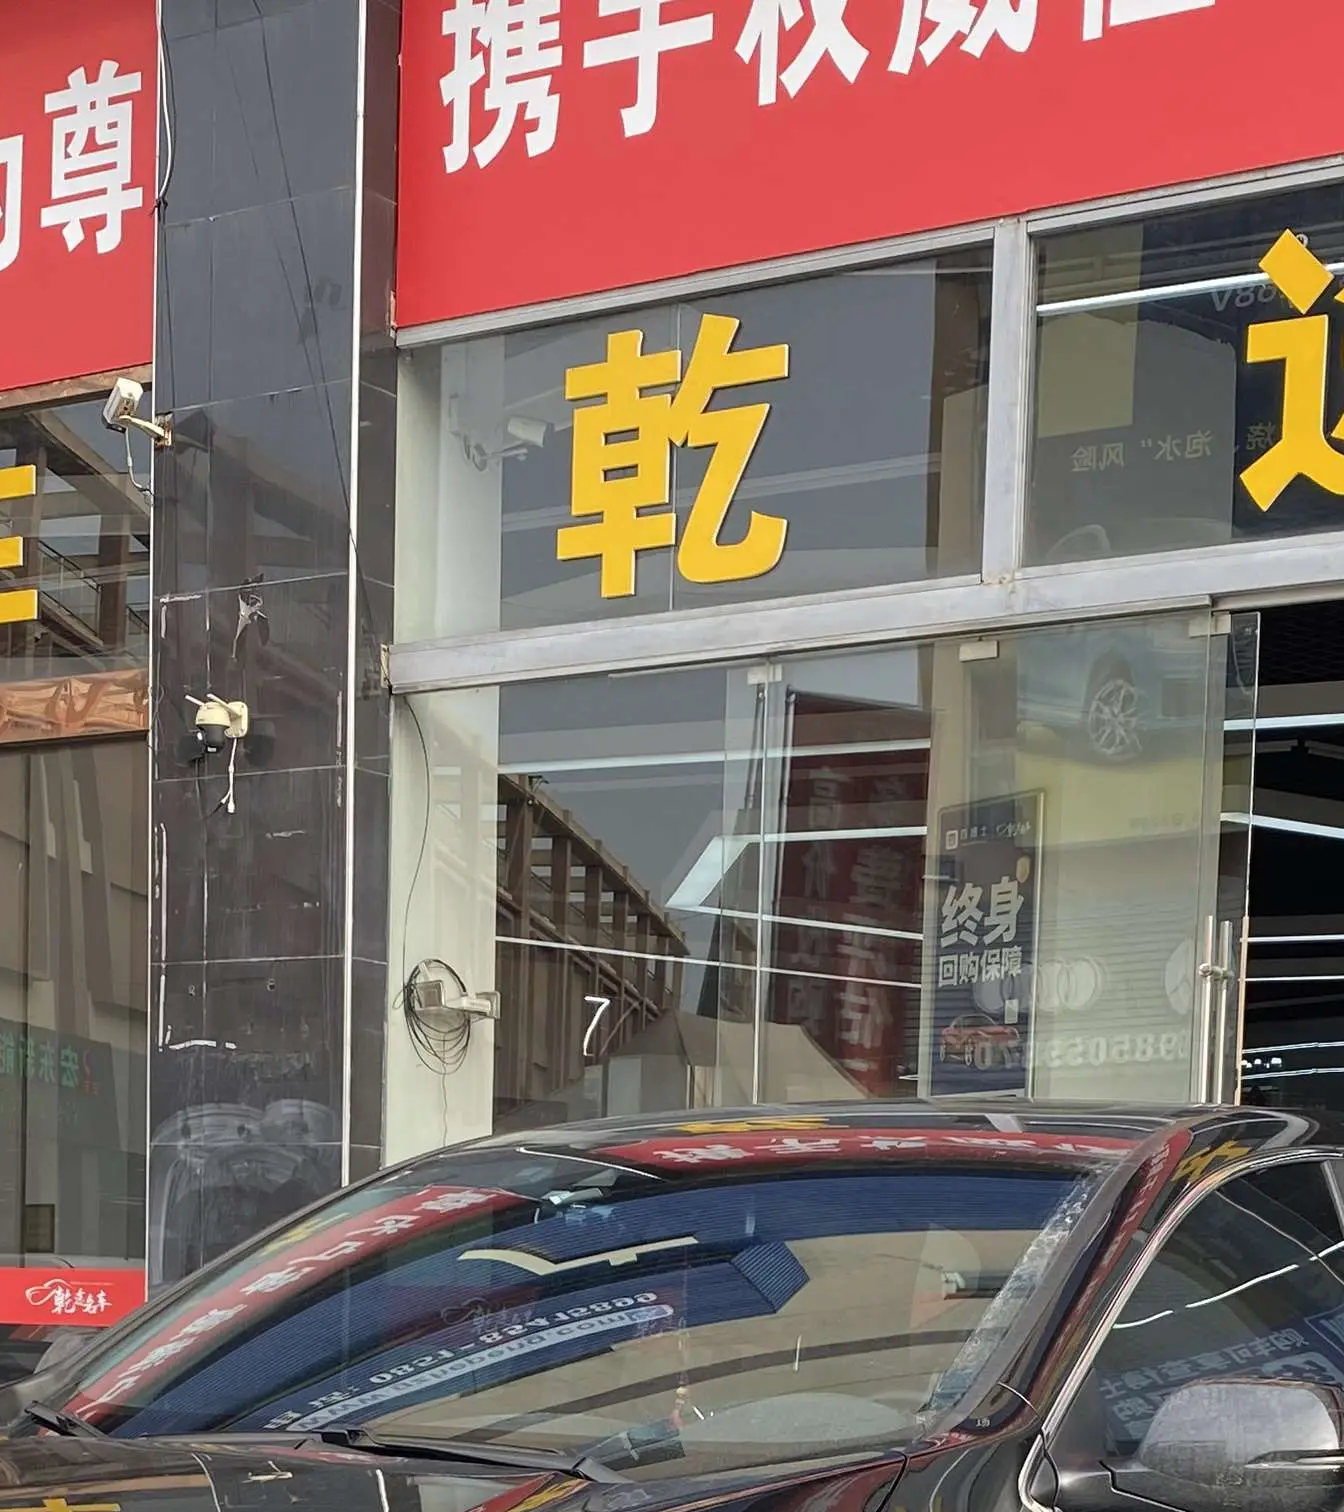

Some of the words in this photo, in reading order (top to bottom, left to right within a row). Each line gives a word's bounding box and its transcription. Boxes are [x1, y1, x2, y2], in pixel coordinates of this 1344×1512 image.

[940, 876, 1025, 948] 终身
[938, 945, 1023, 988] 回购保障
